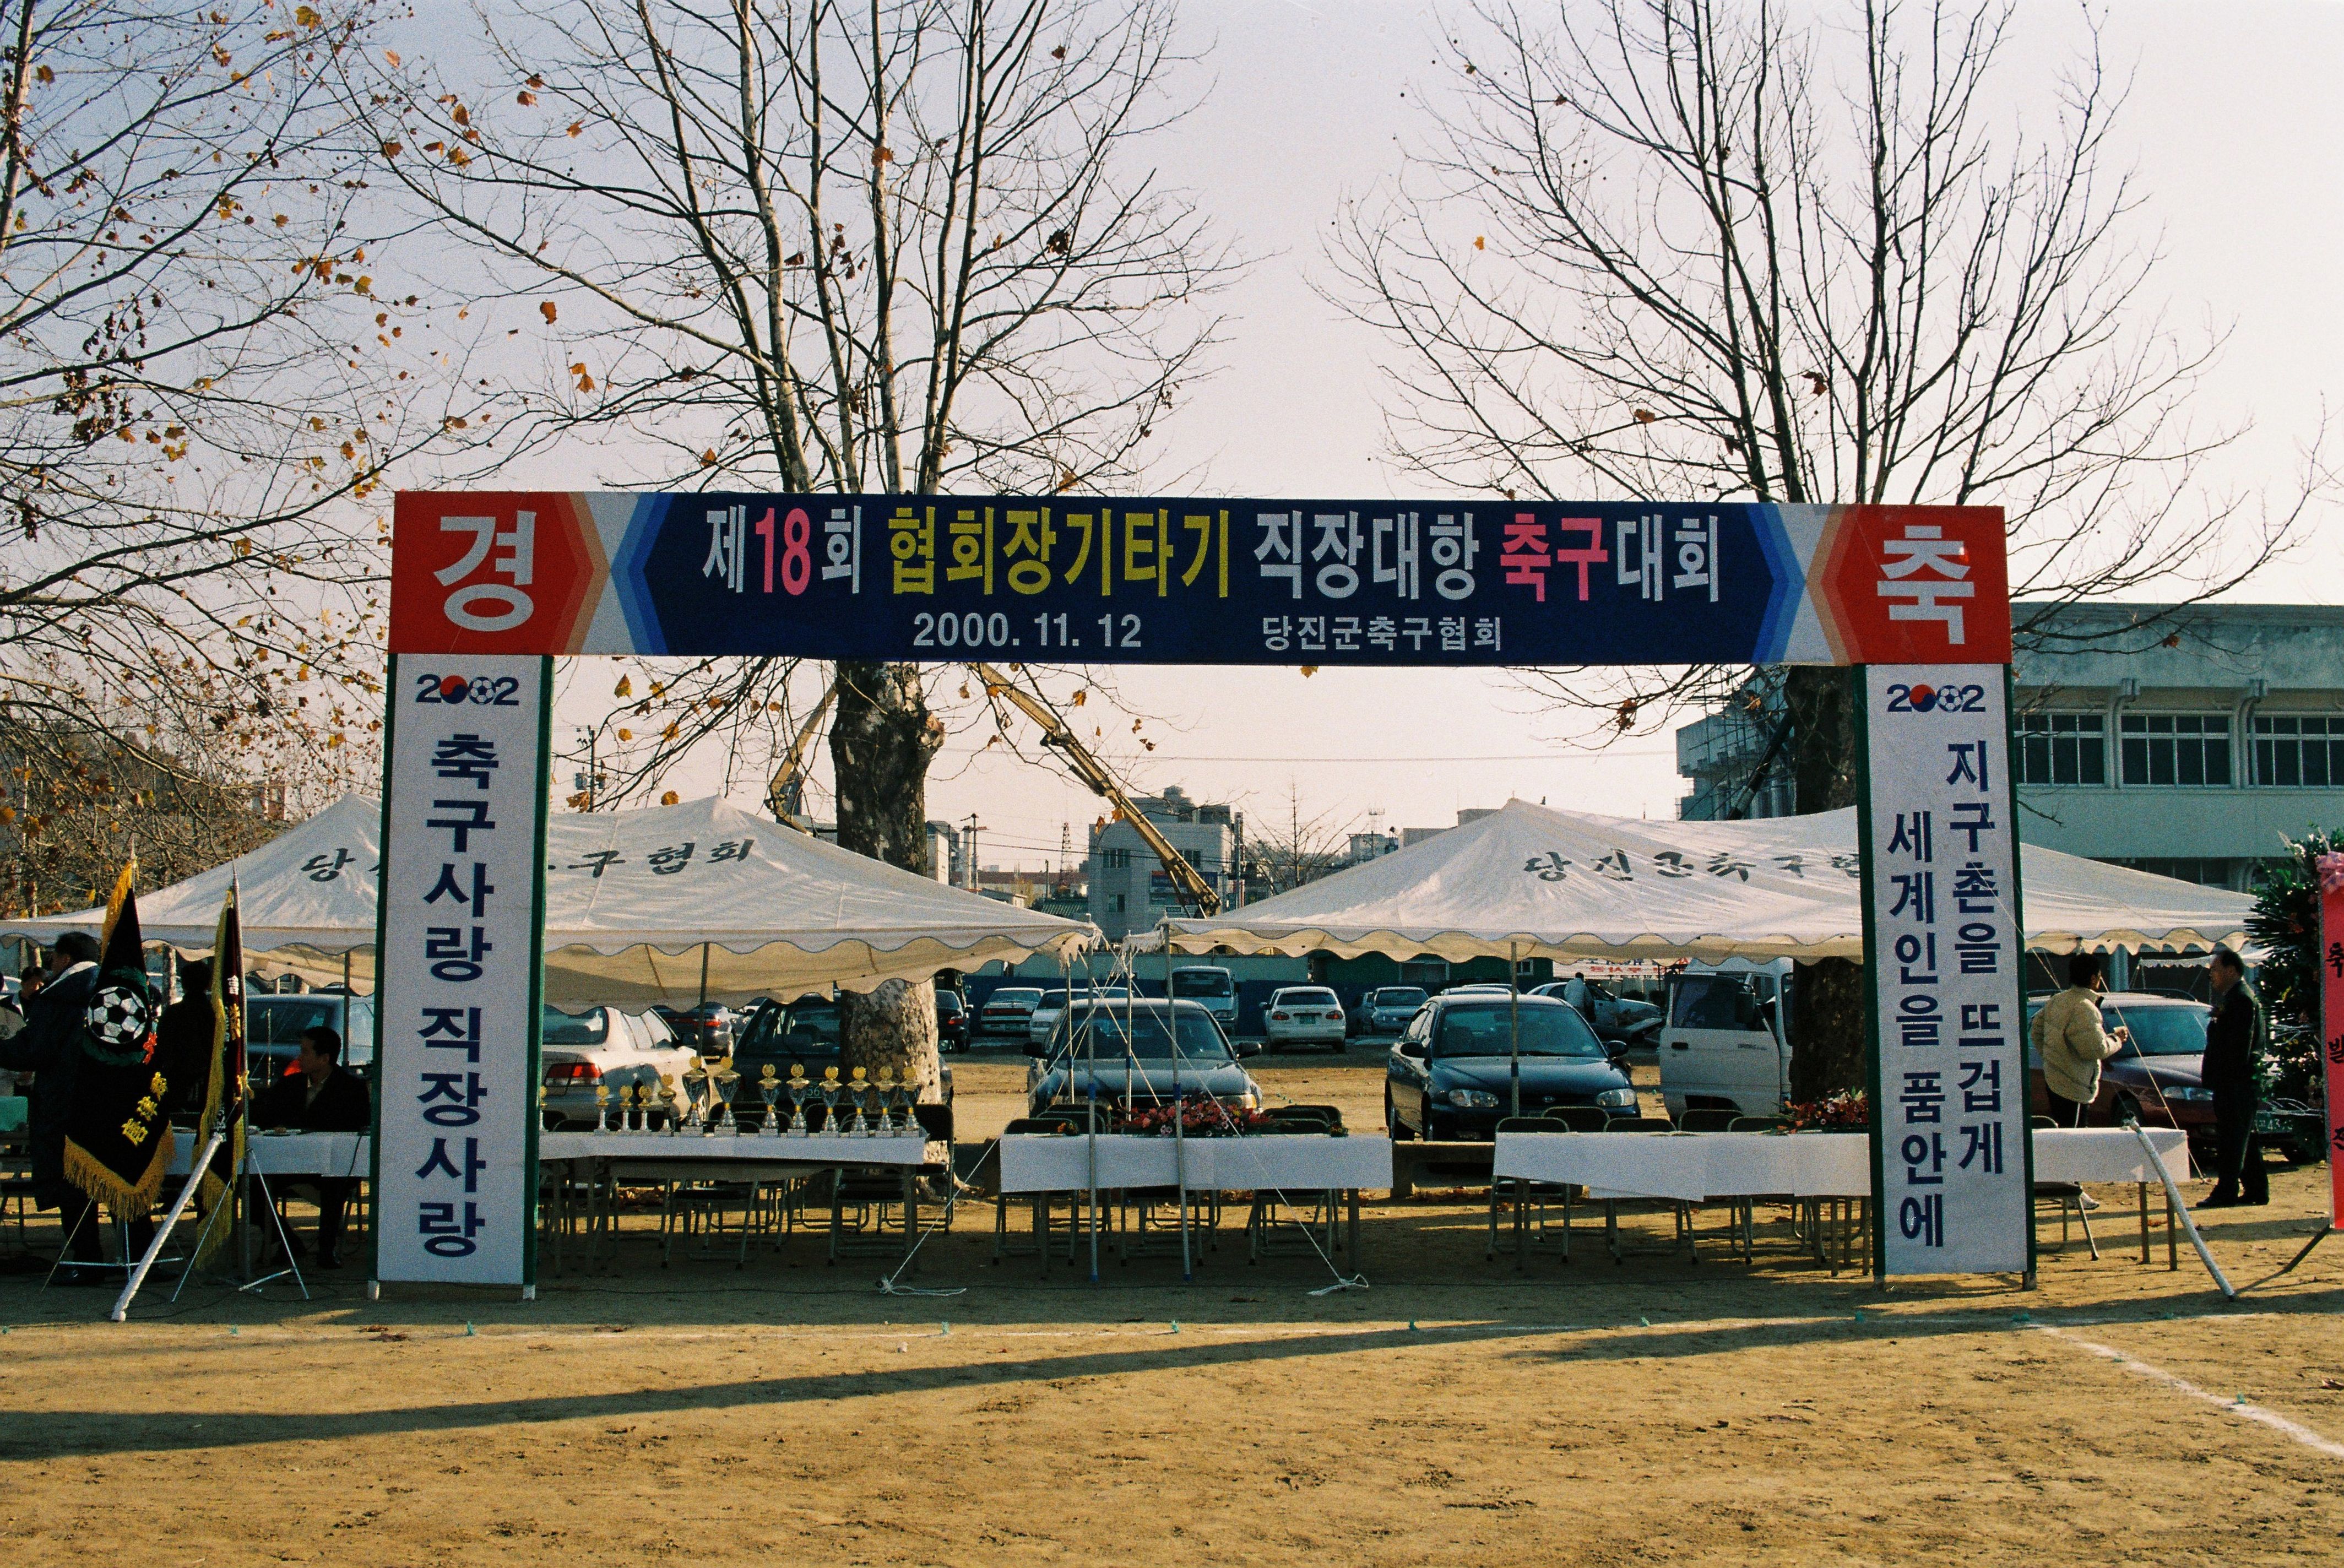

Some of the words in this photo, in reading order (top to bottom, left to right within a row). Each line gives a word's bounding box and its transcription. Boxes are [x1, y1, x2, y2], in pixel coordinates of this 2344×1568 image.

[435, 511, 536, 632] 경
[703, 504, 861, 595] 제18회
[888, 506, 1229, 598] 협회장기타기
[1254, 510, 1480, 600] 직장대항
[1500, 513, 1719, 603] 축구대회
[1877, 525, 1975, 644] 축
[415, 674, 519, 706] 2002
[913, 612, 1019, 647] 2000.
[1034, 612, 1079, 647] 11.
[1098, 614, 1142, 647] 12
[1262, 616, 1501, 652] 당진군축구협회
[1887, 683, 1986, 713] 2002
[423, 733, 500, 983] 축구사랑
[1945, 739, 2001, 975] 지구촌을
[1887, 810, 1944, 1047] 세계인을
[415, 1006, 488, 1259] 직장사랑
[1957, 1003, 2005, 1175] 뜨겁게
[1899, 1071, 1948, 1249] 품안에
